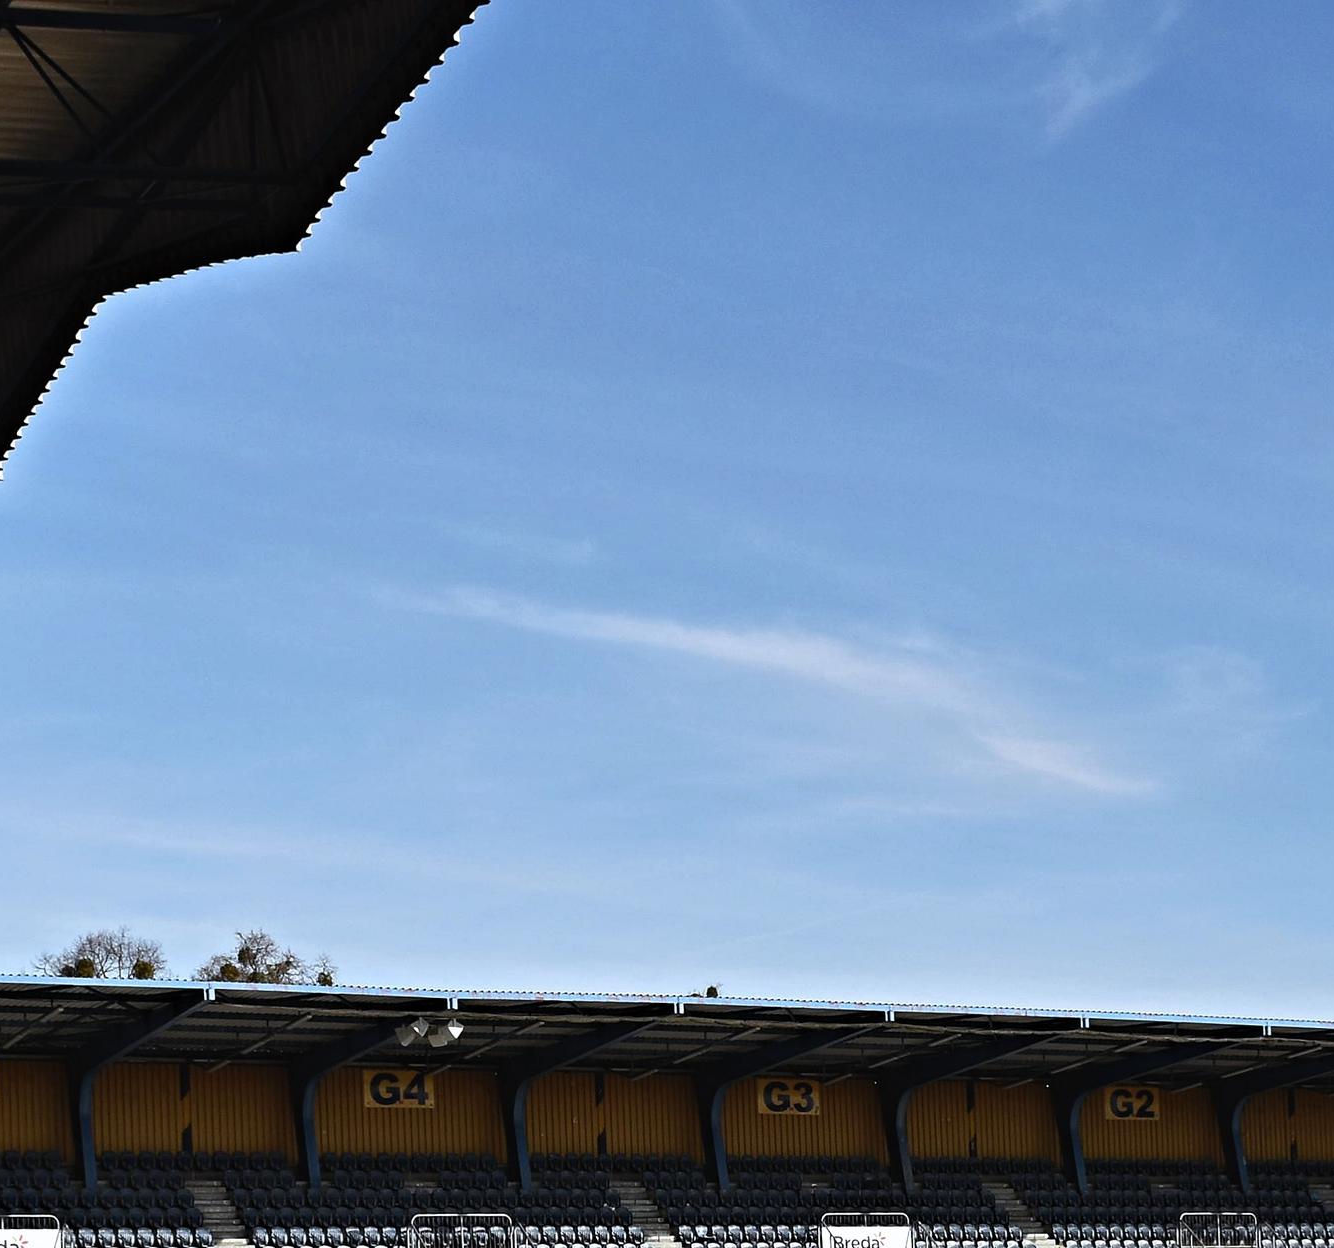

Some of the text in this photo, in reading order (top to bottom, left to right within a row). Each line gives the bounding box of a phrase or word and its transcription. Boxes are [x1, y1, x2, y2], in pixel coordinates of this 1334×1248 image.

[370, 1072, 429, 1105] G4
[763, 1081, 814, 1112] G3
[1110, 1088, 1155, 1118] G2
